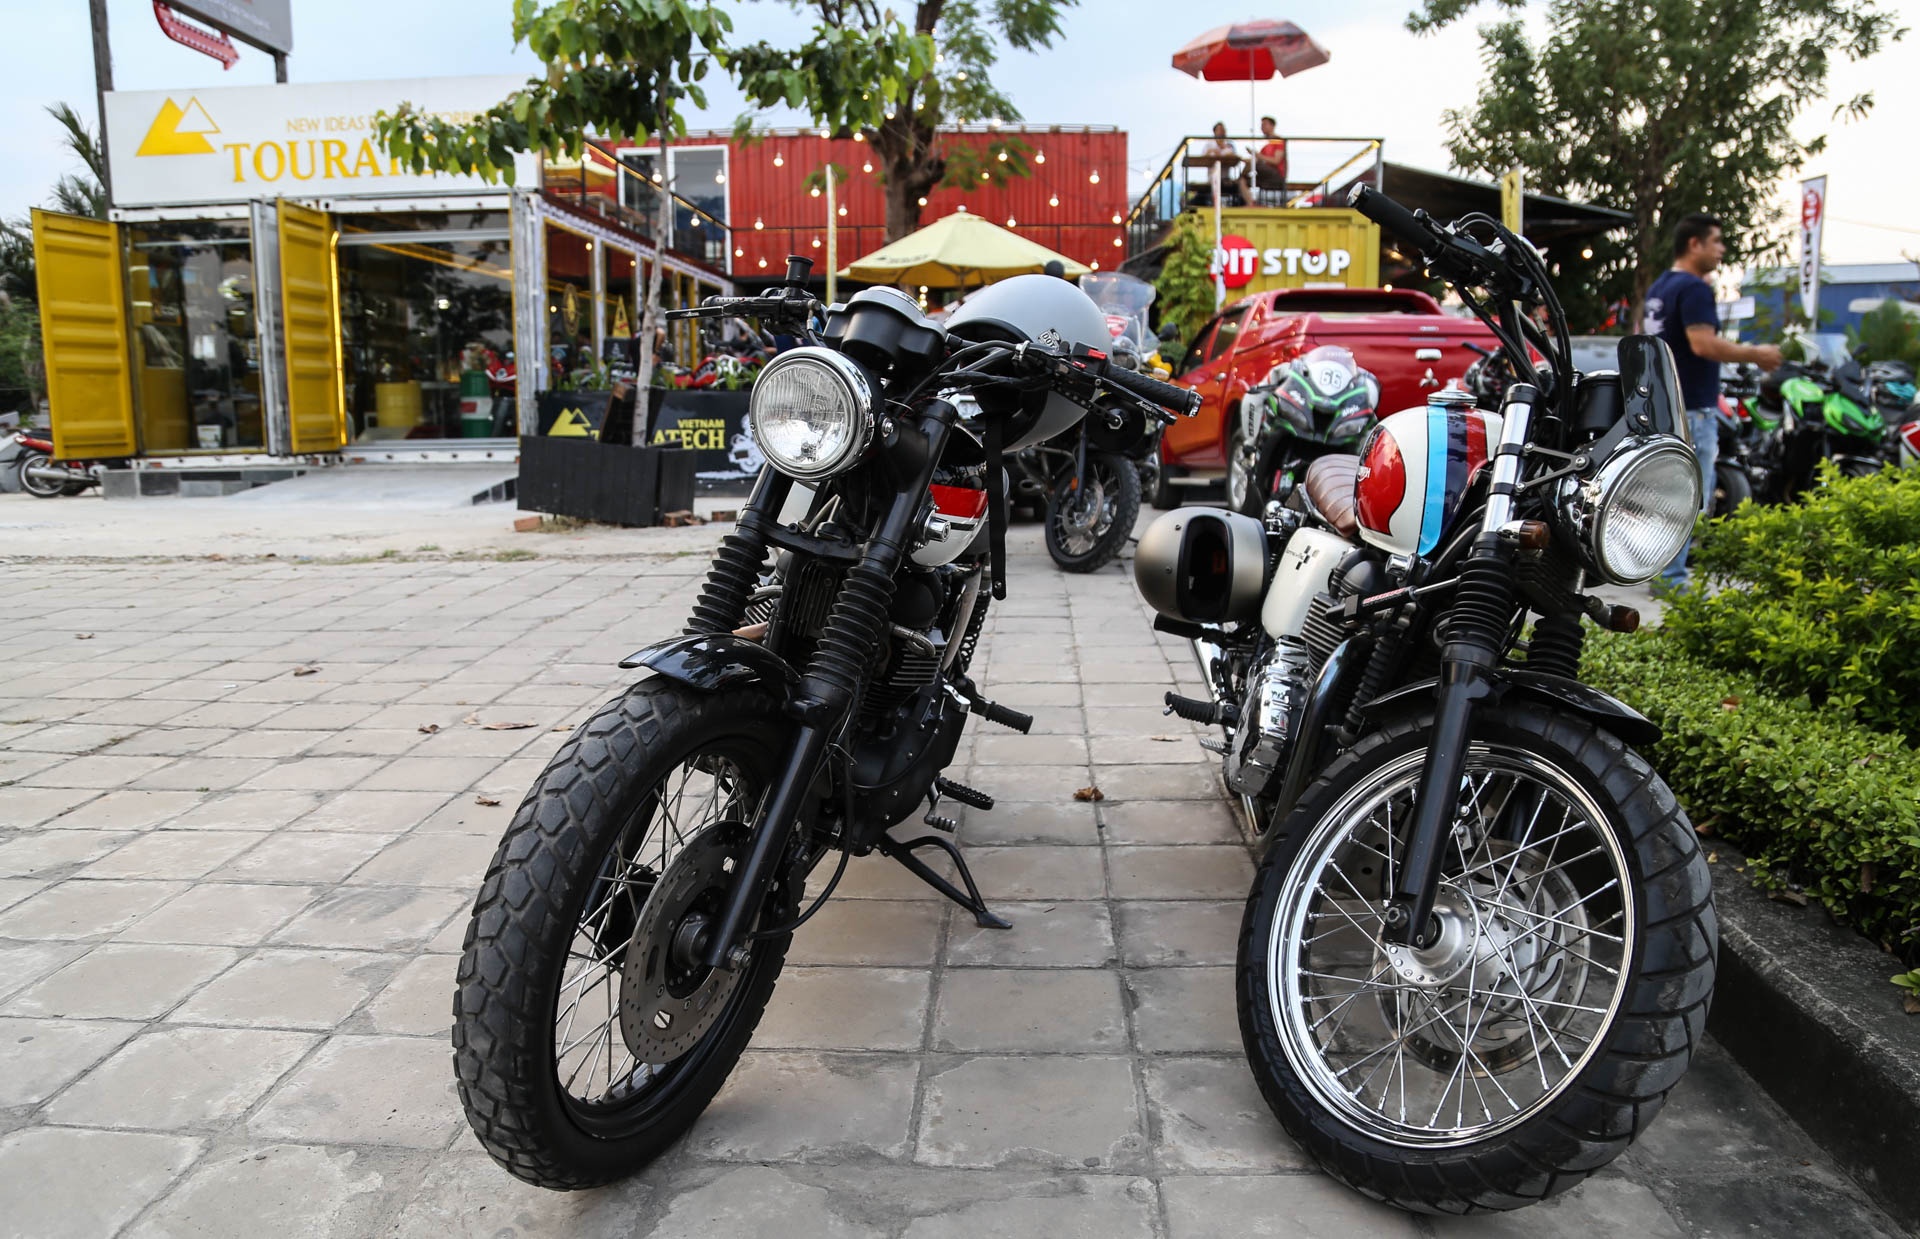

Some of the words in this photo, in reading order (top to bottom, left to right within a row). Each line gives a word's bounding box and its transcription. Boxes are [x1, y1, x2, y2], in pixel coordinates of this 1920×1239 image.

[287, 117, 320, 133] NEW
[325, 115, 364, 131] IDEAS
[223, 138, 503, 183] TOURA
[1210, 248, 1259, 275] PIT
[1262, 248, 1351, 276] STOP
[1321, 369, 1342, 388] 66
[677, 419, 726, 429] VIETNAM
[590, 428, 726, 450] TATECH
